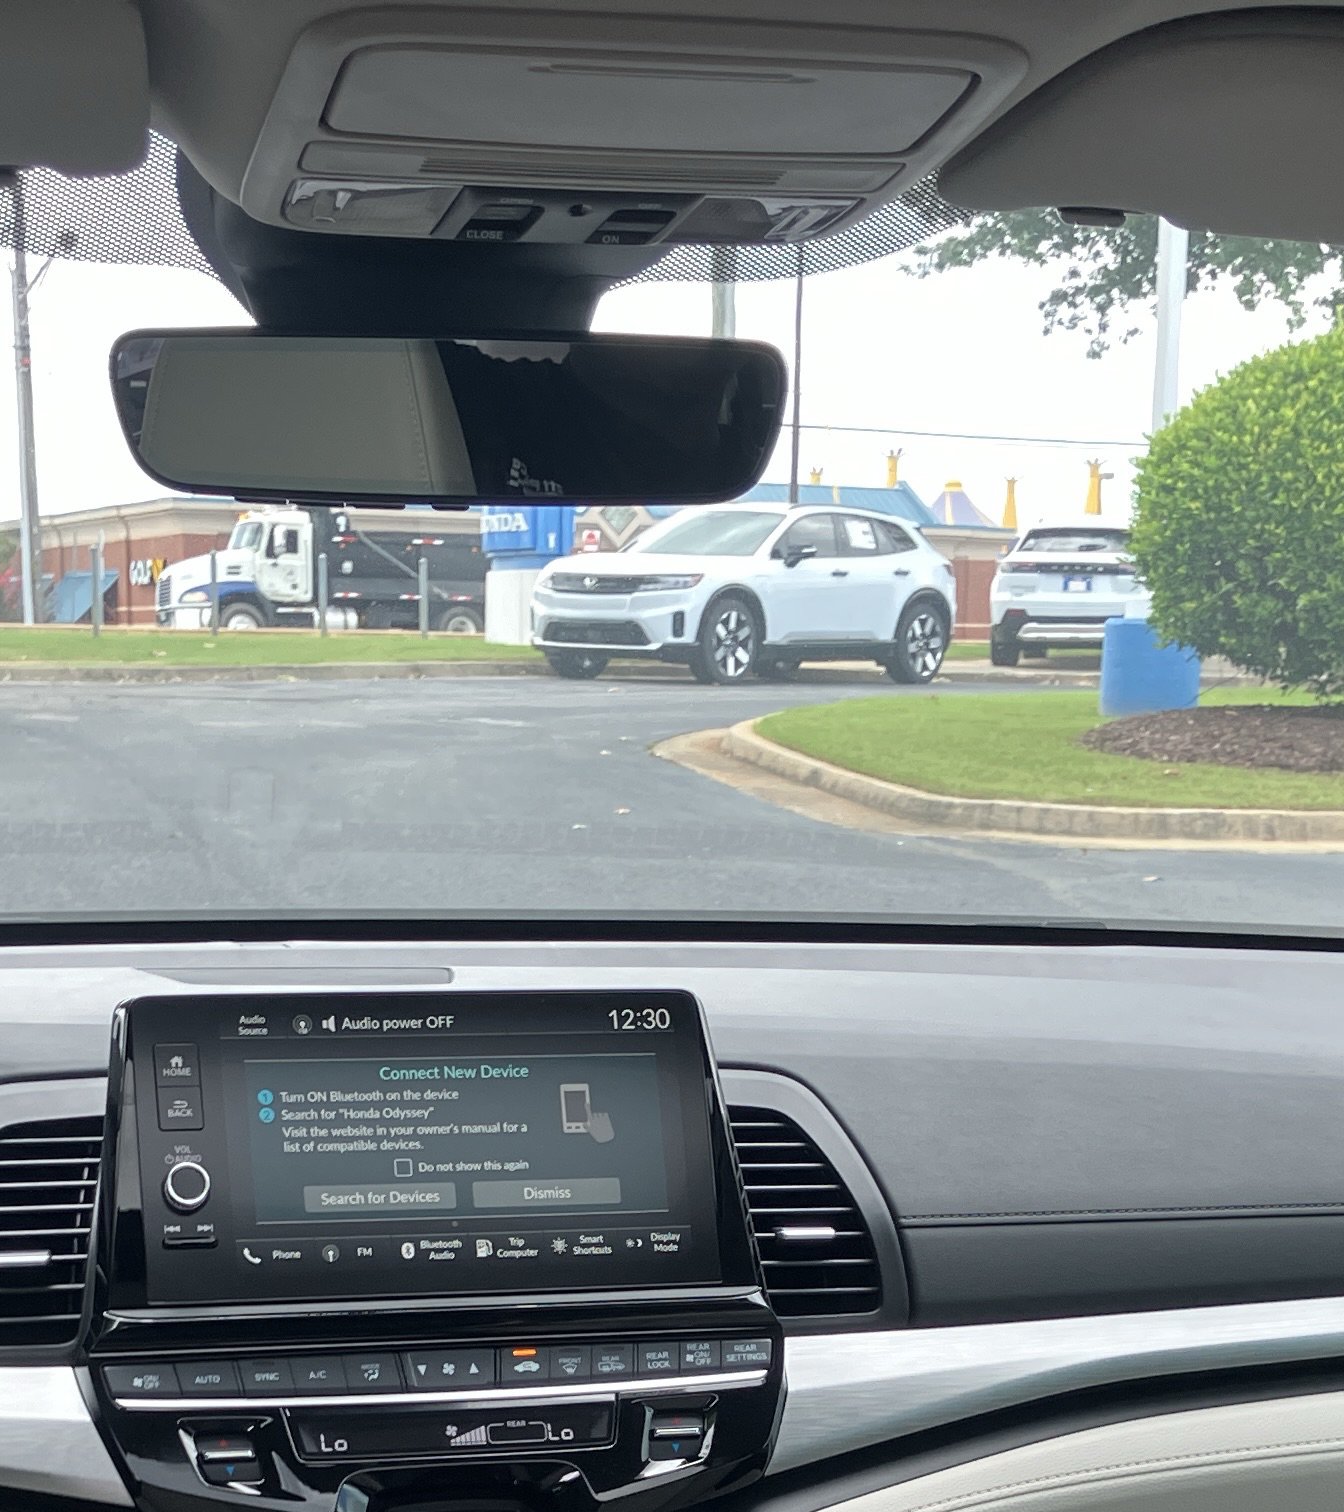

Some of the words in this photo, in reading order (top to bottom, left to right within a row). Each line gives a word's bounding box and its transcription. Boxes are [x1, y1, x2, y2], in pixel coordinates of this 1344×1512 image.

[465, 230, 504, 240] CLOSE
[601, 234, 620, 244] ON
[239, 1014, 266, 1025] Audio
[342, 1017, 380, 1030] Audio
[382, 1018, 423, 1032] power
[425, 1015, 455, 1029] OFF
[607, 1007, 672, 1031] 12:30
[238, 1026, 269, 1036] Source
[162, 1067, 192, 1078] HOME
[379, 1065, 441, 1081] Connect
[444, 1065, 477, 1079] New
[480, 1064, 530, 1079] Device
[279, 1091, 305, 1103] Turn
[307, 1090, 327, 1102] ON
[330, 1089, 385, 1102] Bluetooth
[386, 1092, 400, 1102] on
[402, 1090, 422, 1101] the
[424, 1088, 460, 1100] device
[167, 1107, 193, 1119] BACK
[281, 1108, 318, 1121] Search
[320, 1108, 337, 1120] for
[338, 1107, 380, 1120] "Honda
[282, 1126, 307, 1139] Visit
[310, 1126, 329, 1138] the
[330, 1125, 374, 1137] website
[376, 1125, 387, 1136] in
[390, 1126, 415, 1138] your
[417, 1123, 459, 1135] owner's
[461, 1123, 501, 1134] manual
[502, 1122, 518, 1133] for
[520, 1124, 528, 1133] a
[173, 1145, 192, 1154] VOL
[283, 1141, 300, 1153] list
[302, 1140, 315, 1152] of
[316, 1139, 378, 1153] compatible
[379, 1139, 425, 1151] devices.
[418, 1162, 434, 1173] Do
[436, 1162, 454, 1172] not
[455, 1161, 482, 1172] show
[483, 1160, 502, 1171] this
[503, 1160, 529, 1173] again
[320, 1191, 366, 1206] Search
[367, 1191, 388, 1204] for
[389, 1190, 441, 1204] Devices
[523, 1187, 572, 1200] Dismiss
[507, 1236, 525, 1248] Trip
[579, 1233, 605, 1244] Smart
[649, 1231, 681, 1243] Display
[419, 1239, 463, 1251] Bluetooth
[572, 1244, 613, 1256] Shortcuts
[653, 1242, 679, 1253] Mode
[272, 1249, 302, 1260] Phone
[356, 1247, 373, 1257] FM
[429, 1249, 456, 1260] Audio
[496, 1247, 539, 1259] Computer
[686, 1342, 711, 1351] REAR
[733, 1343, 758, 1352] REAR
[645, 1351, 670, 1360] REAR
[725, 1352, 768, 1362] SETTINGS
[647, 1360, 672, 1369] LOCK
[695, 1358, 712, 1367] OFF
[194, 1375, 221, 1385] AUTO
[254, 1372, 280, 1382] SYNC
[308, 1369, 327, 1380] A/C
[506, 1420, 526, 1428] REAR
[547, 1423, 575, 1441] Lo
[319, 1432, 349, 1453] Lo
